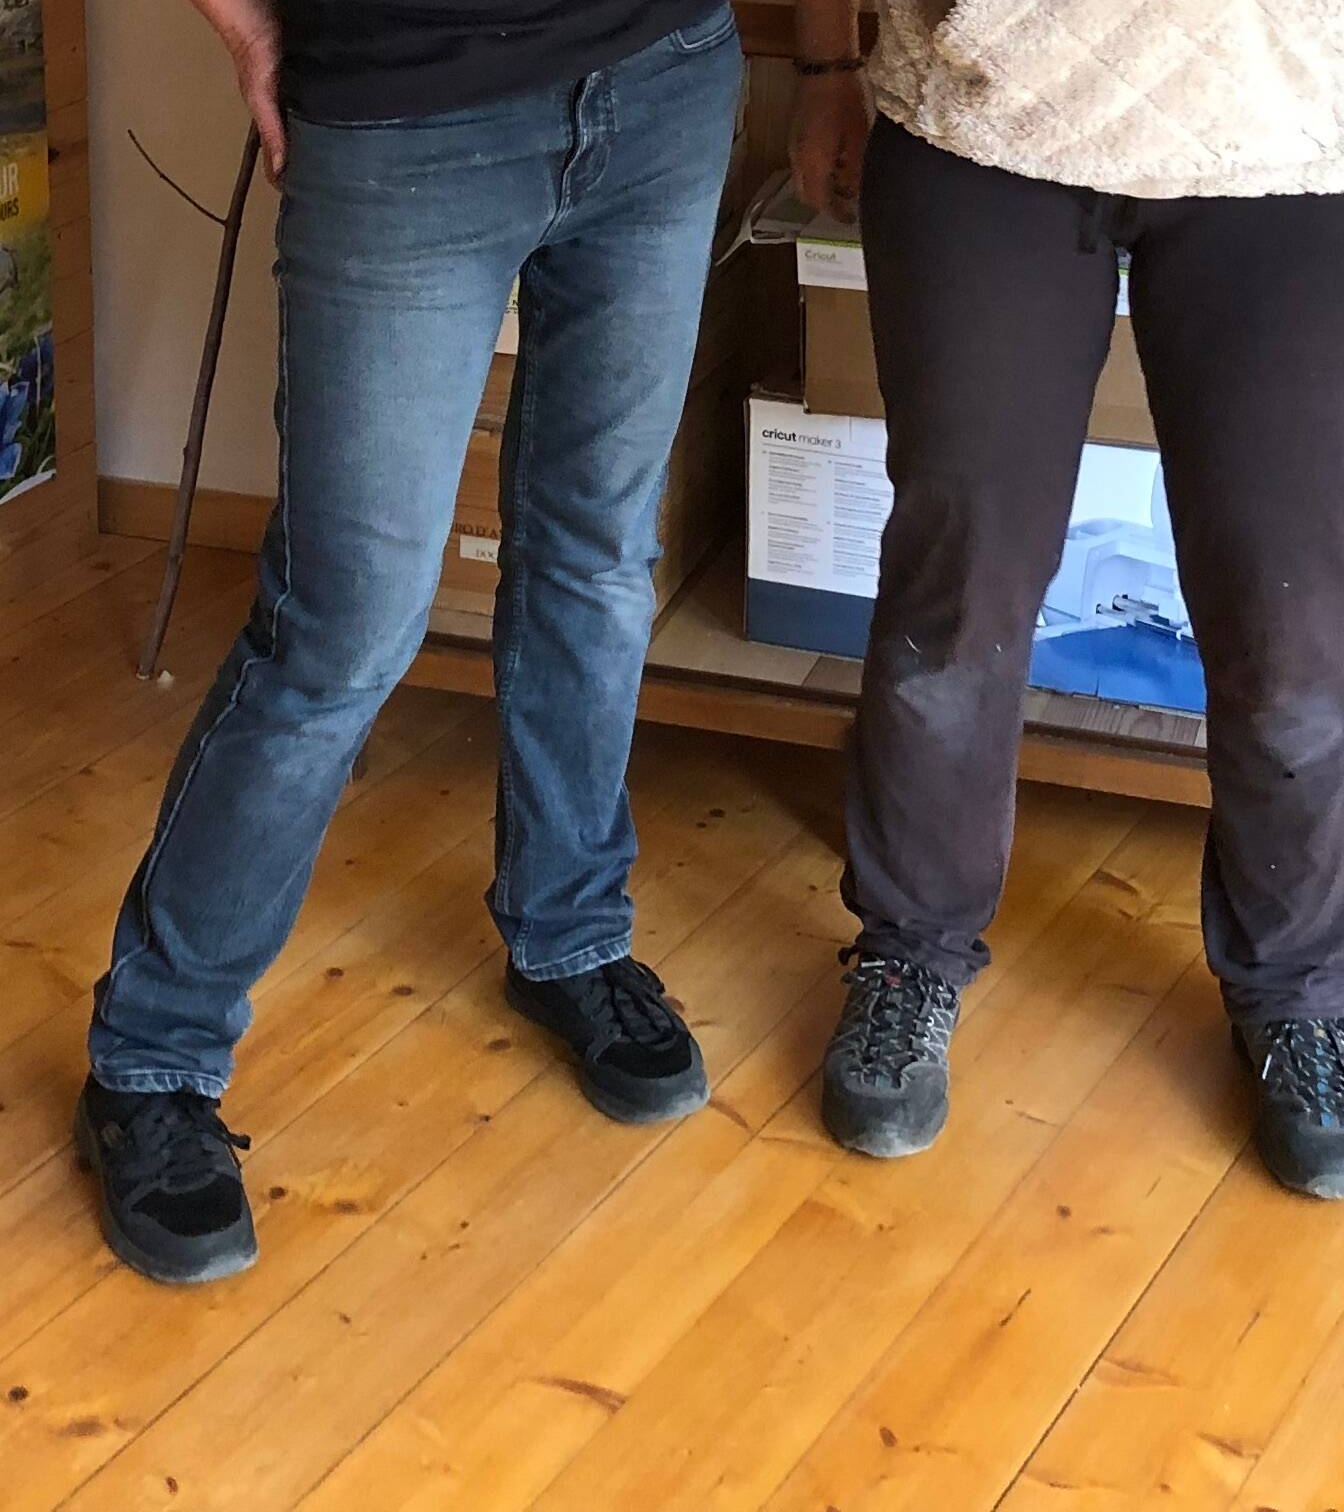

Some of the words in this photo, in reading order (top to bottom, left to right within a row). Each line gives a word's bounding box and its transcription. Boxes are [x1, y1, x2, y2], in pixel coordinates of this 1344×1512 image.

[762, 428, 797, 442] cricut
[799, 434, 832, 448] maker
[835, 439, 841, 448] 3
